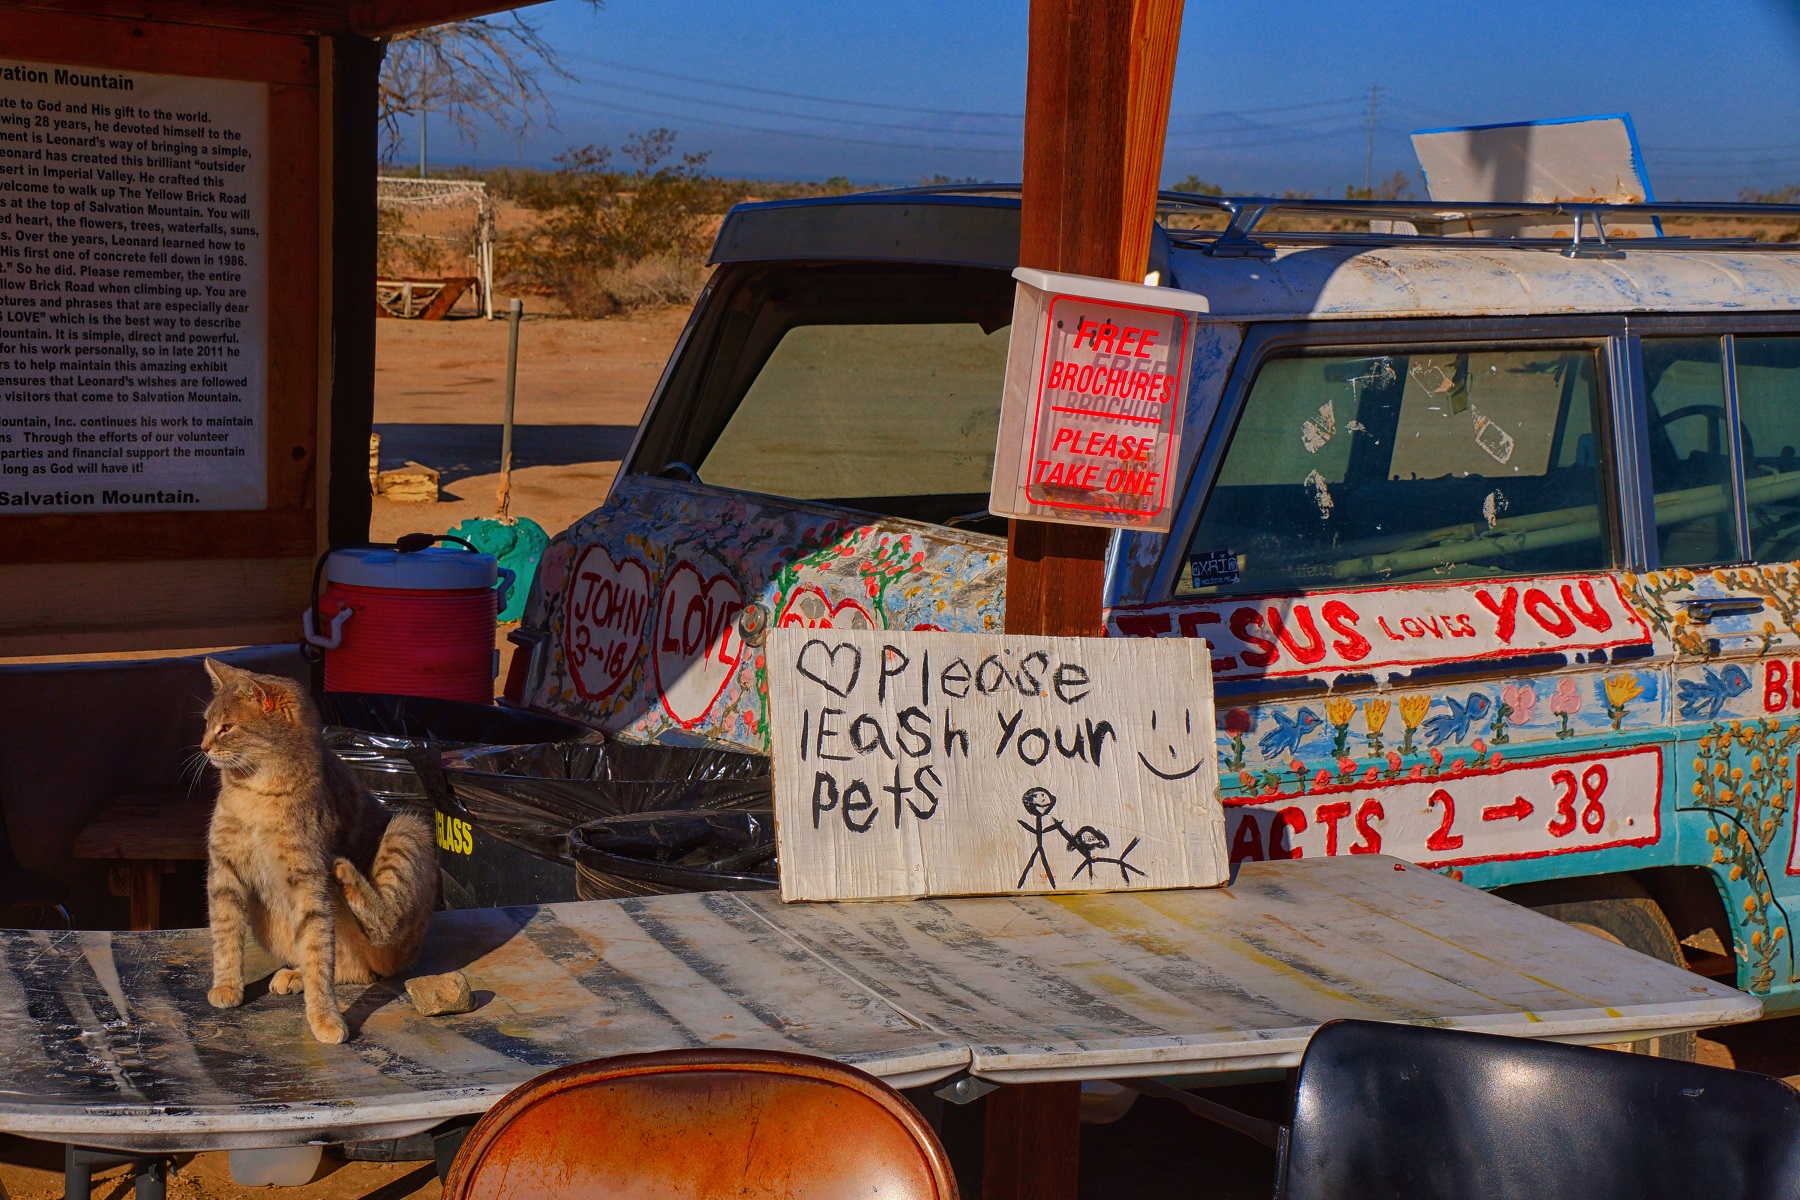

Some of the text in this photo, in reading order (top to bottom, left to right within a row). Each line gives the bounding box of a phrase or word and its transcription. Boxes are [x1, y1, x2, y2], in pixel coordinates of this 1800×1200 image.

[54, 68, 134, 91] Mountain
[20, 98, 212, 123] to God and His gift to the world.
[34, 115, 241, 141] 28 years, he devoted himself to the
[32, 131, 43, 144] is
[108, 140, 133, 153] way
[136, 139, 148, 151] of
[151, 140, 198, 157] bringing
[201, 146, 208, 154] a
[212, 144, 251, 159] simple,
[45, 149, 68, 162] has
[71, 153, 118, 165] created
[121, 154, 144, 167] this
[147, 156, 191, 170] brilliant
[52, 183, 246, 204] to walk up The Yellow Brick Road
[10, 197, 250, 220] at the top of Salvation Mountain. You will
[16, 213, 259, 238] heart, the flowers, trees, waterfalls, suns,
[0, 245, 248, 267] His first one of concrete fell down in 1986.
[16, 262, 241, 282] So he did. Please remember, the entire
[29, 279, 247, 298] Brick Road when climbing up. You are
[48, 312, 85, 324] which
[88, 313, 99, 325] is
[102, 314, 122, 326] the
[125, 314, 150, 326] best
[153, 318, 176, 329] way
[179, 316, 191, 327] to
[194, 316, 241, 328] describe
[55, 328, 239, 344] It is simple, direct and powerful.
[1073, 321, 1160, 359] FREE
[20, 342, 38, 354] his
[40, 343, 72, 355] work
[75, 344, 138, 358] personally,
[142, 347, 156, 356] so
[158, 345, 169, 356] in
[172, 345, 194, 356] late
[197, 345, 223, 357] 2011
[227, 346, 240, 357] he
[14, 358, 228, 374] to help maintain this amazing exhibit
[49, 375, 74, 386] that
[137, 376, 177, 387] wishes
[180, 378, 198, 387] are
[201, 376, 248, 387] followed
[1048, 361, 1174, 404] BROCHURES
[54, 415, 253, 427] Inc. continues his work to maintain
[0, 446, 245, 462] parties and financial support the mountain
[1052, 428, 1153, 462] PLEASE
[3, 462, 144, 477] long as God will have it!
[1034, 460, 1160, 496] TAKE ONE
[0, 489, 200, 506] Salvation Mountain.
[575, 572, 646, 637] JOHN
[1378, 609, 1476, 642] LOVES
[1474, 580, 1612, 645] YOU
[662, 590, 744, 668] LOVE
[1229, 763, 1608, 863] ACTS 2 38
